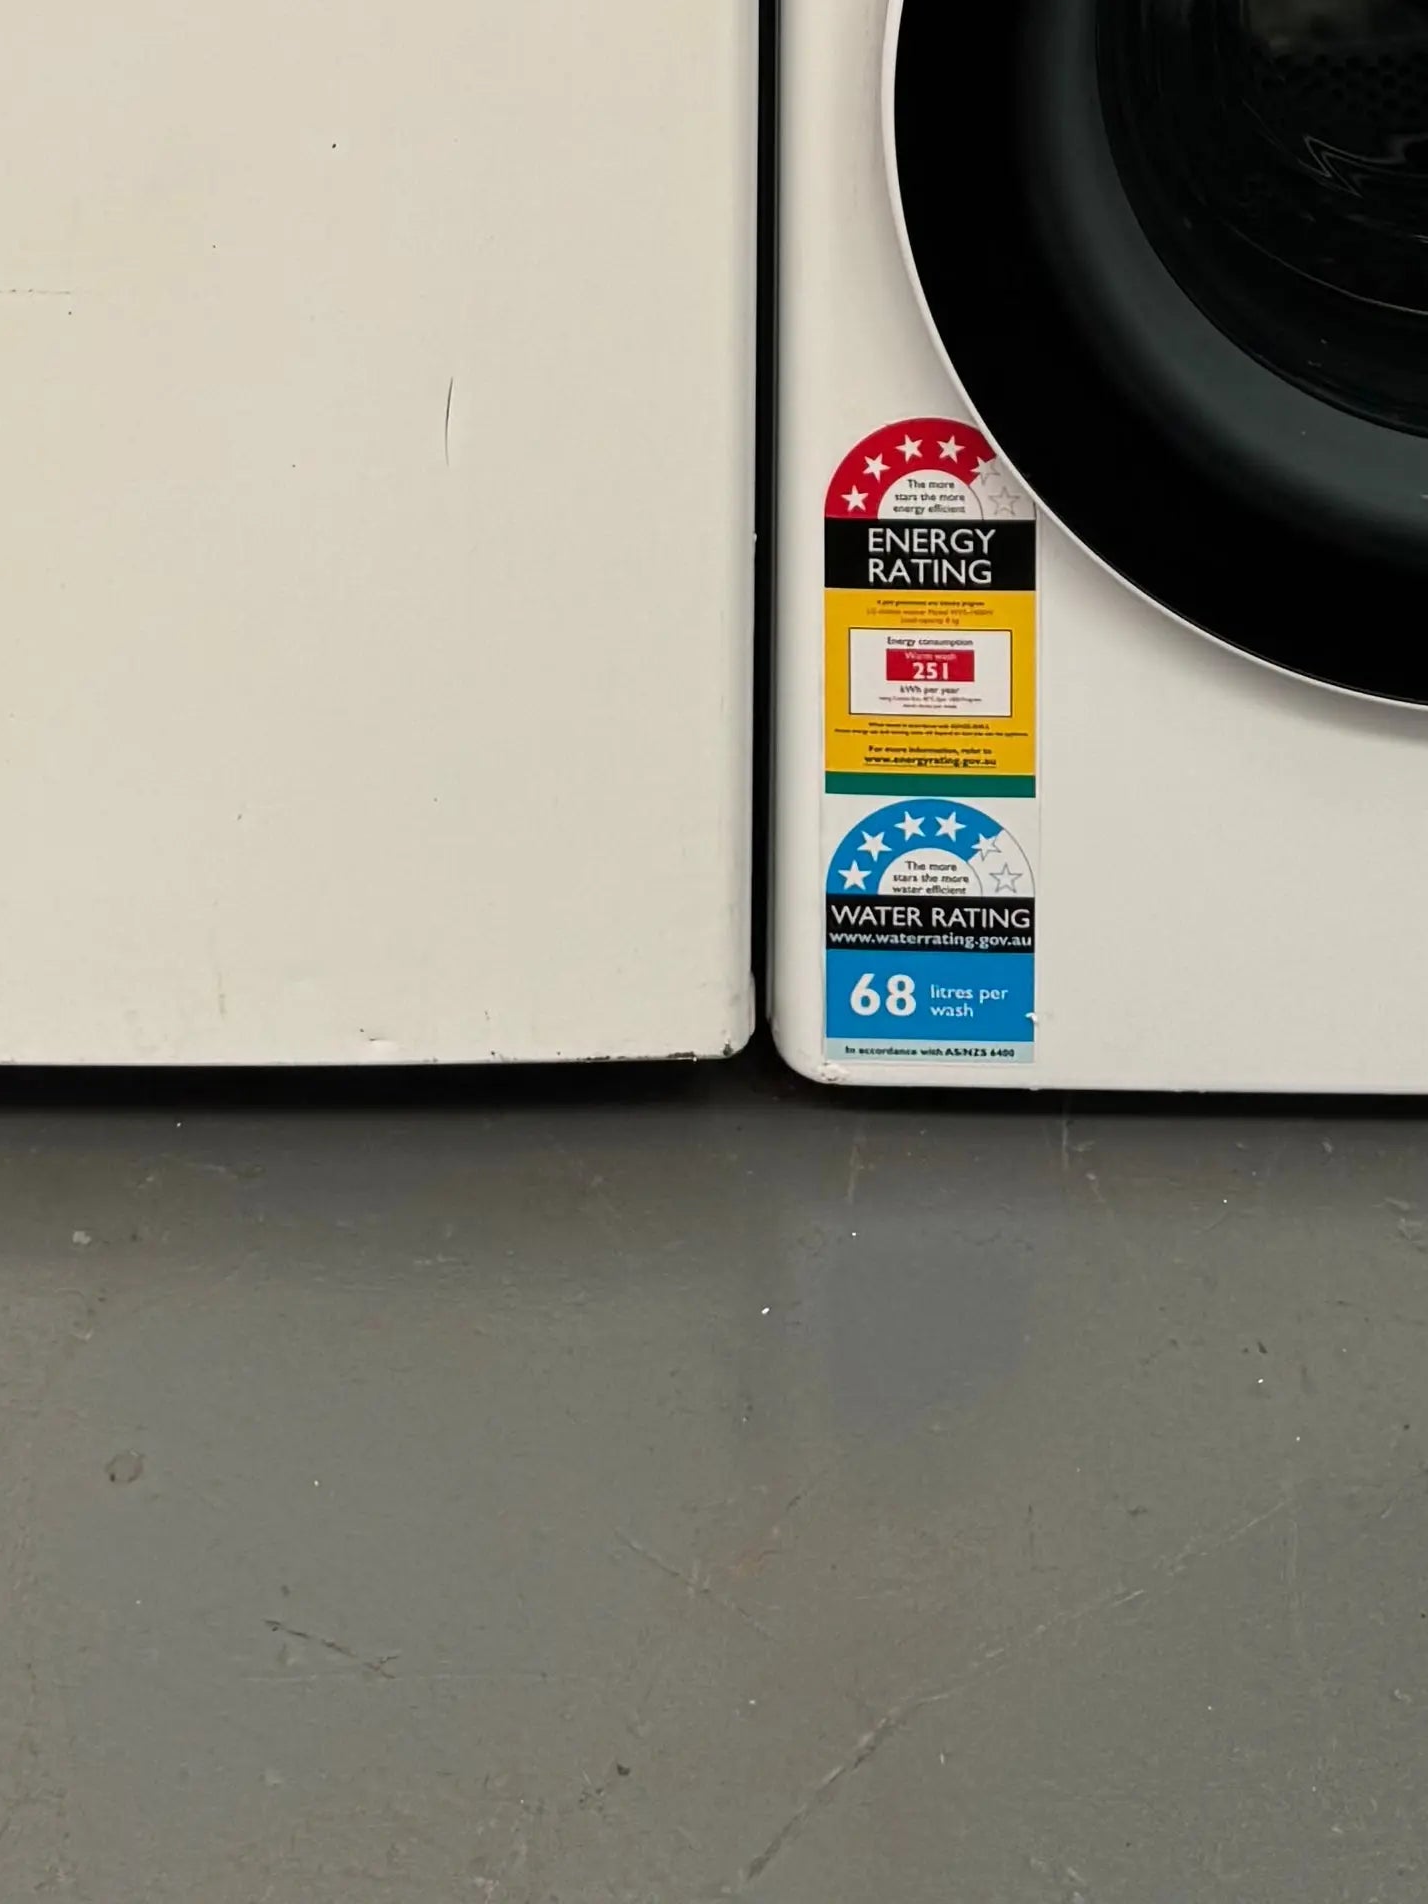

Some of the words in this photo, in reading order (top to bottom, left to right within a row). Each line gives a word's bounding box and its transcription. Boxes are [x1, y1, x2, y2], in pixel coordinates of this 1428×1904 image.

[908, 479, 926, 489] The
[929, 481, 955, 489] more
[895, 493, 918, 501] stars
[921, 492, 935, 501] the
[893, 506, 925, 515] energy
[929, 505, 966, 513] efficient
[868, 528, 996, 554] ENERGY
[868, 558, 992, 584] RATING
[887, 636, 915, 647] Energy
[918, 638, 973, 648] consumption
[913, 662, 949, 680] 251
[926, 687, 939, 696] per
[942, 687, 960, 696] year
[905, 861, 925, 871] The
[929, 863, 957, 871] more
[893, 874, 918, 882] stars
[922, 873, 937, 882] the
[941, 875, 969, 883] more
[893, 886, 922, 894] water
[926, 885, 966, 894] efficient
[831, 905, 923, 927] WATER
[932, 907, 1030, 928] RATING
[829, 932, 1032, 949] www.waterrating.gov.au
[850, 973, 916, 1016] 68
[930, 984, 973, 999] litres
[979, 988, 1009, 1003] per
[930, 1002, 974, 1017] wash
[859, 1047, 917, 1055] accordance
[921, 1047, 943, 1055] with
[990, 1049, 1015, 1058] 6400
